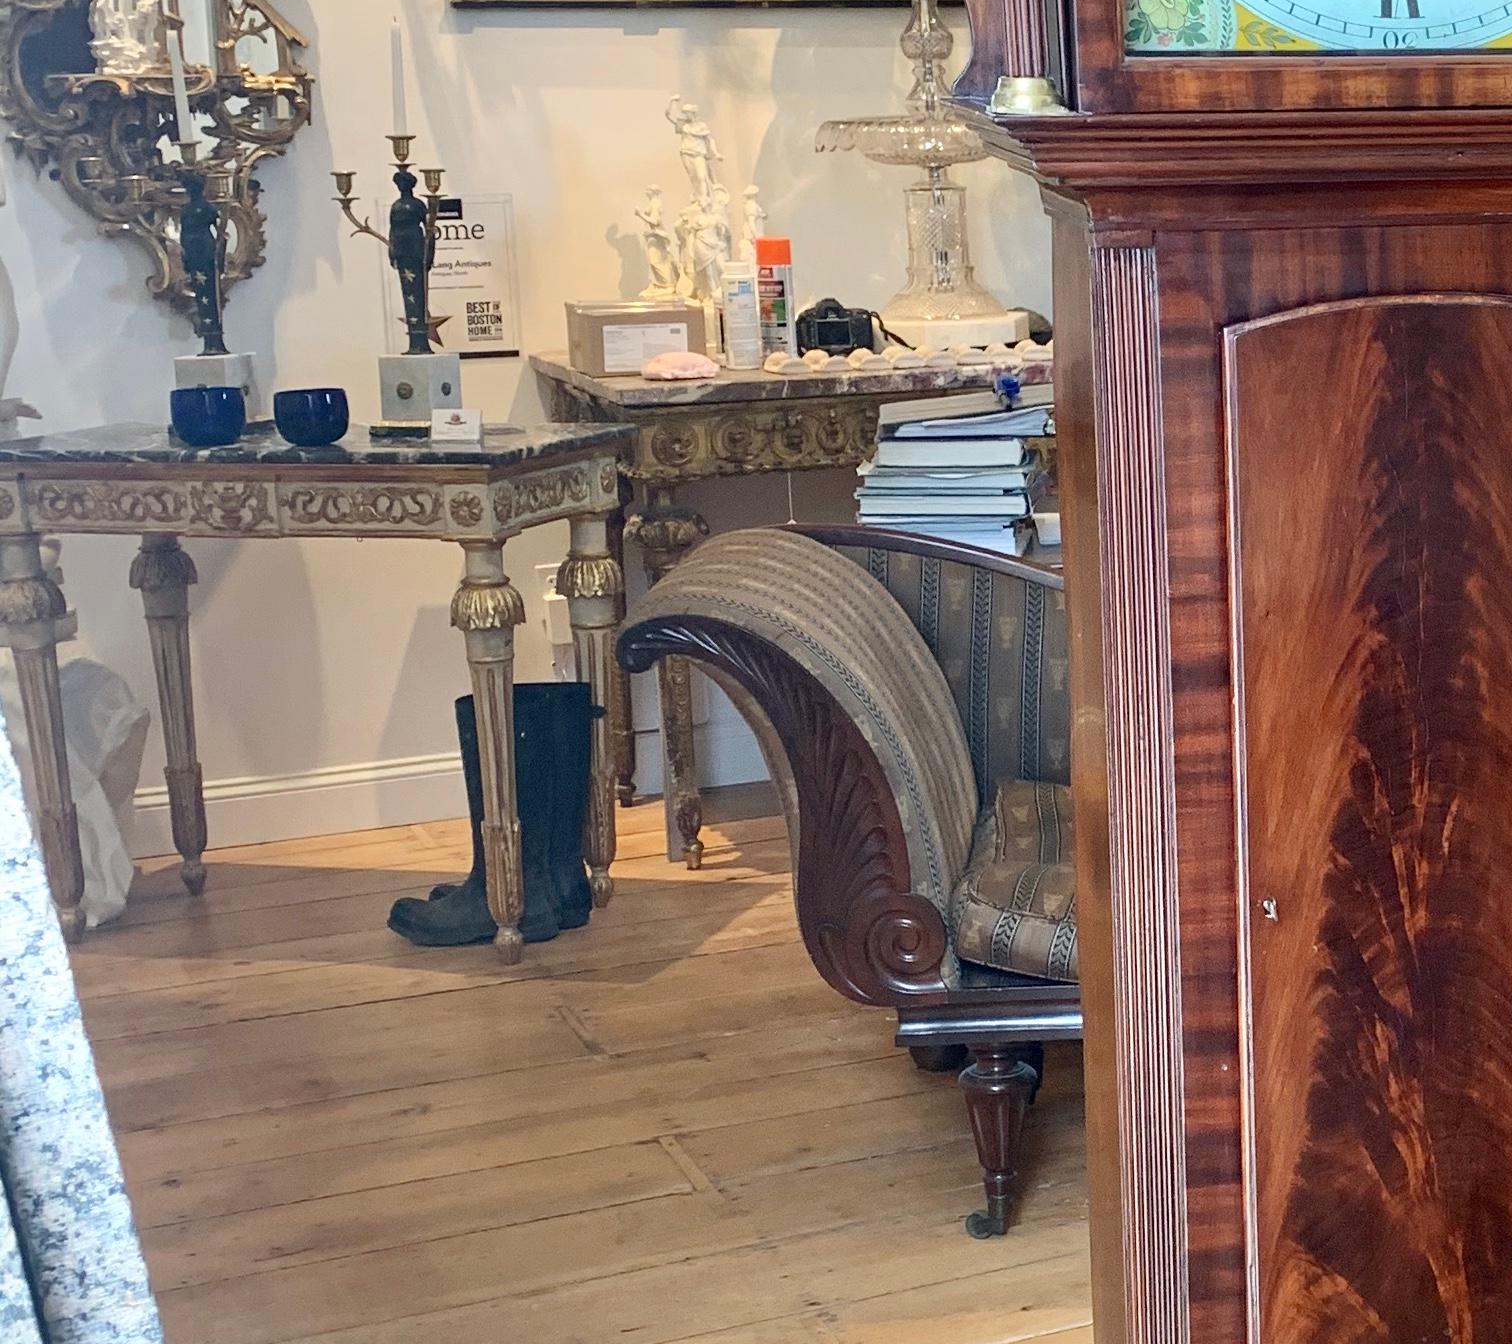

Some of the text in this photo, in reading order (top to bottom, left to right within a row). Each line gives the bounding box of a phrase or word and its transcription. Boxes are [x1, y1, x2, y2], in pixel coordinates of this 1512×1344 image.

[432, 223, 485, 241] ome
[466, 301, 491, 314] BEST
[467, 314, 503, 326] BOSTON
[467, 325, 493, 336] HOME
